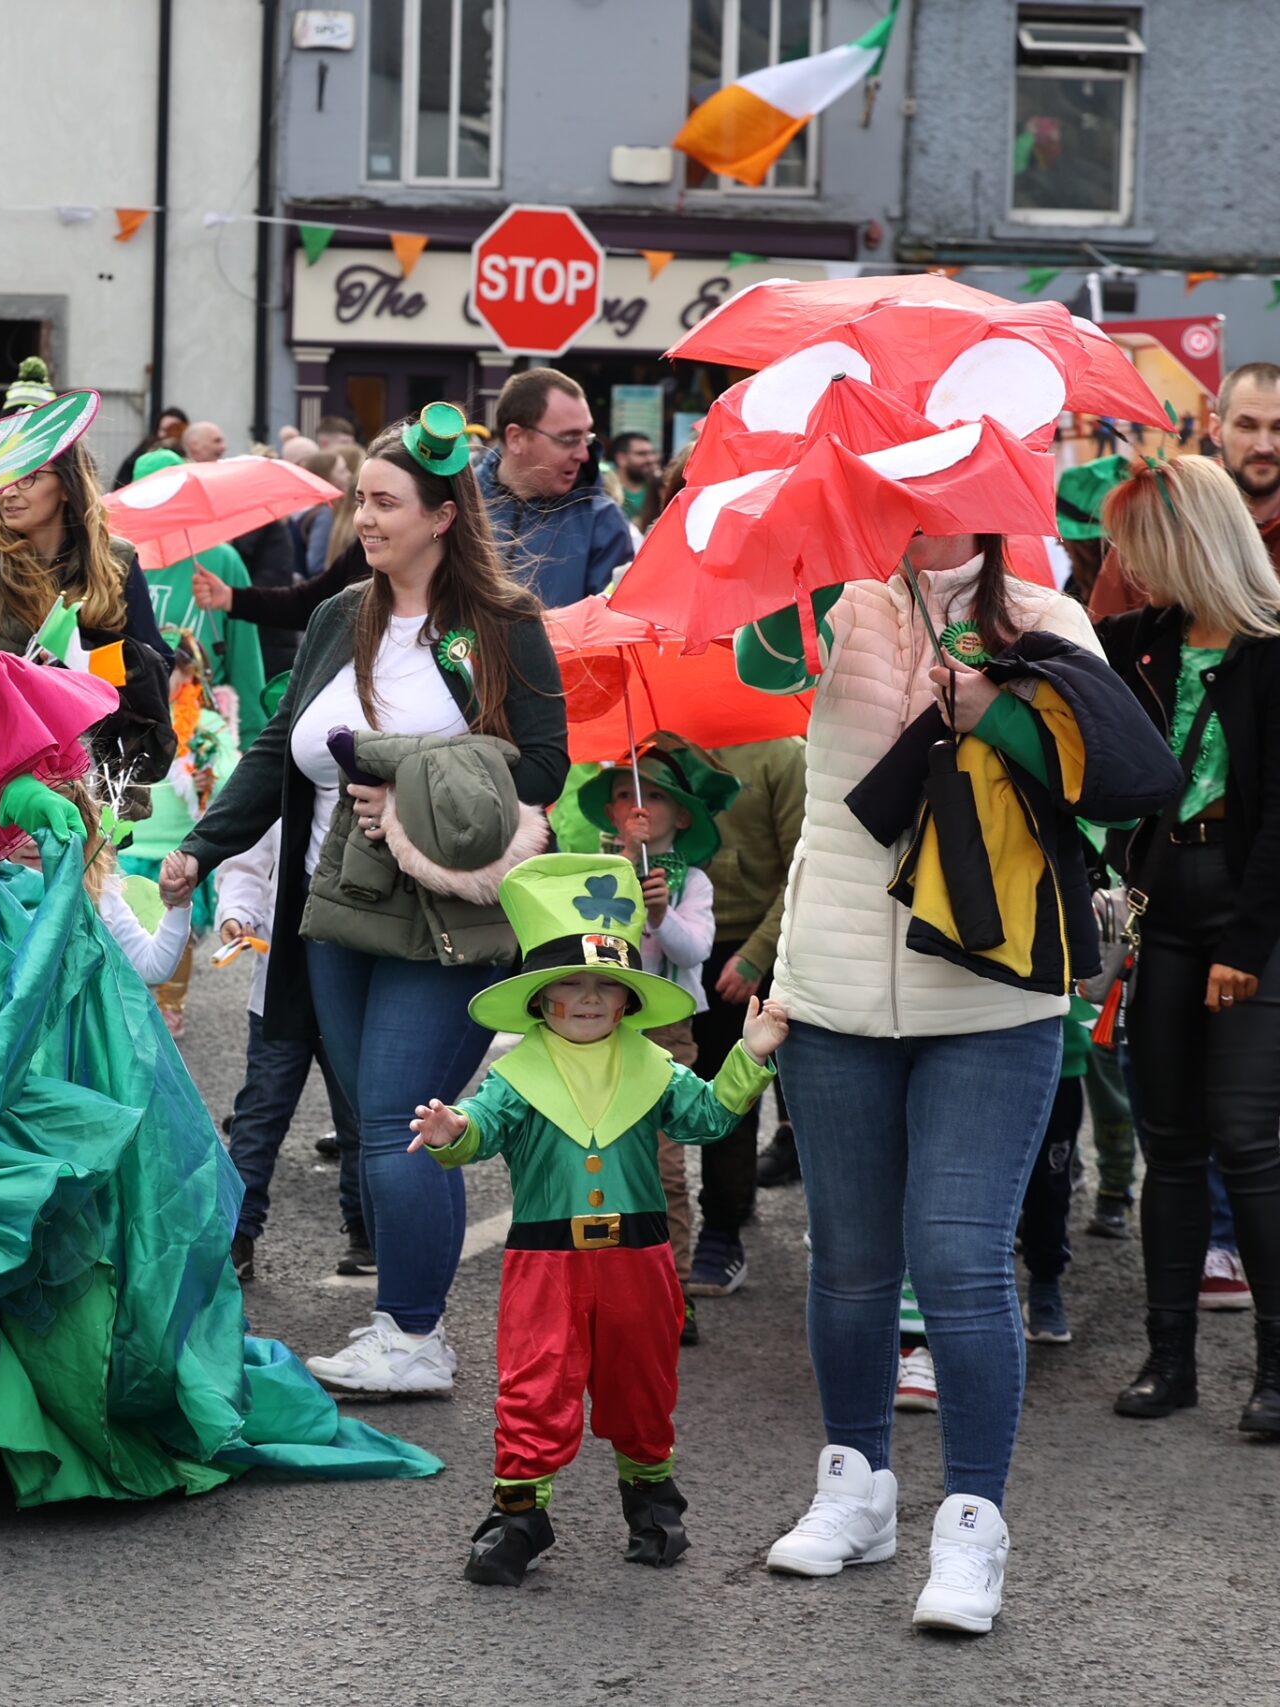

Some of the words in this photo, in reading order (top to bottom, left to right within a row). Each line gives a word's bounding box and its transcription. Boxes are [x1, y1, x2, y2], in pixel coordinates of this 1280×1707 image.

[335, 264, 426, 323] The
[478, 254, 596, 306] STOP
[959, 1521, 975, 1529] FILA
